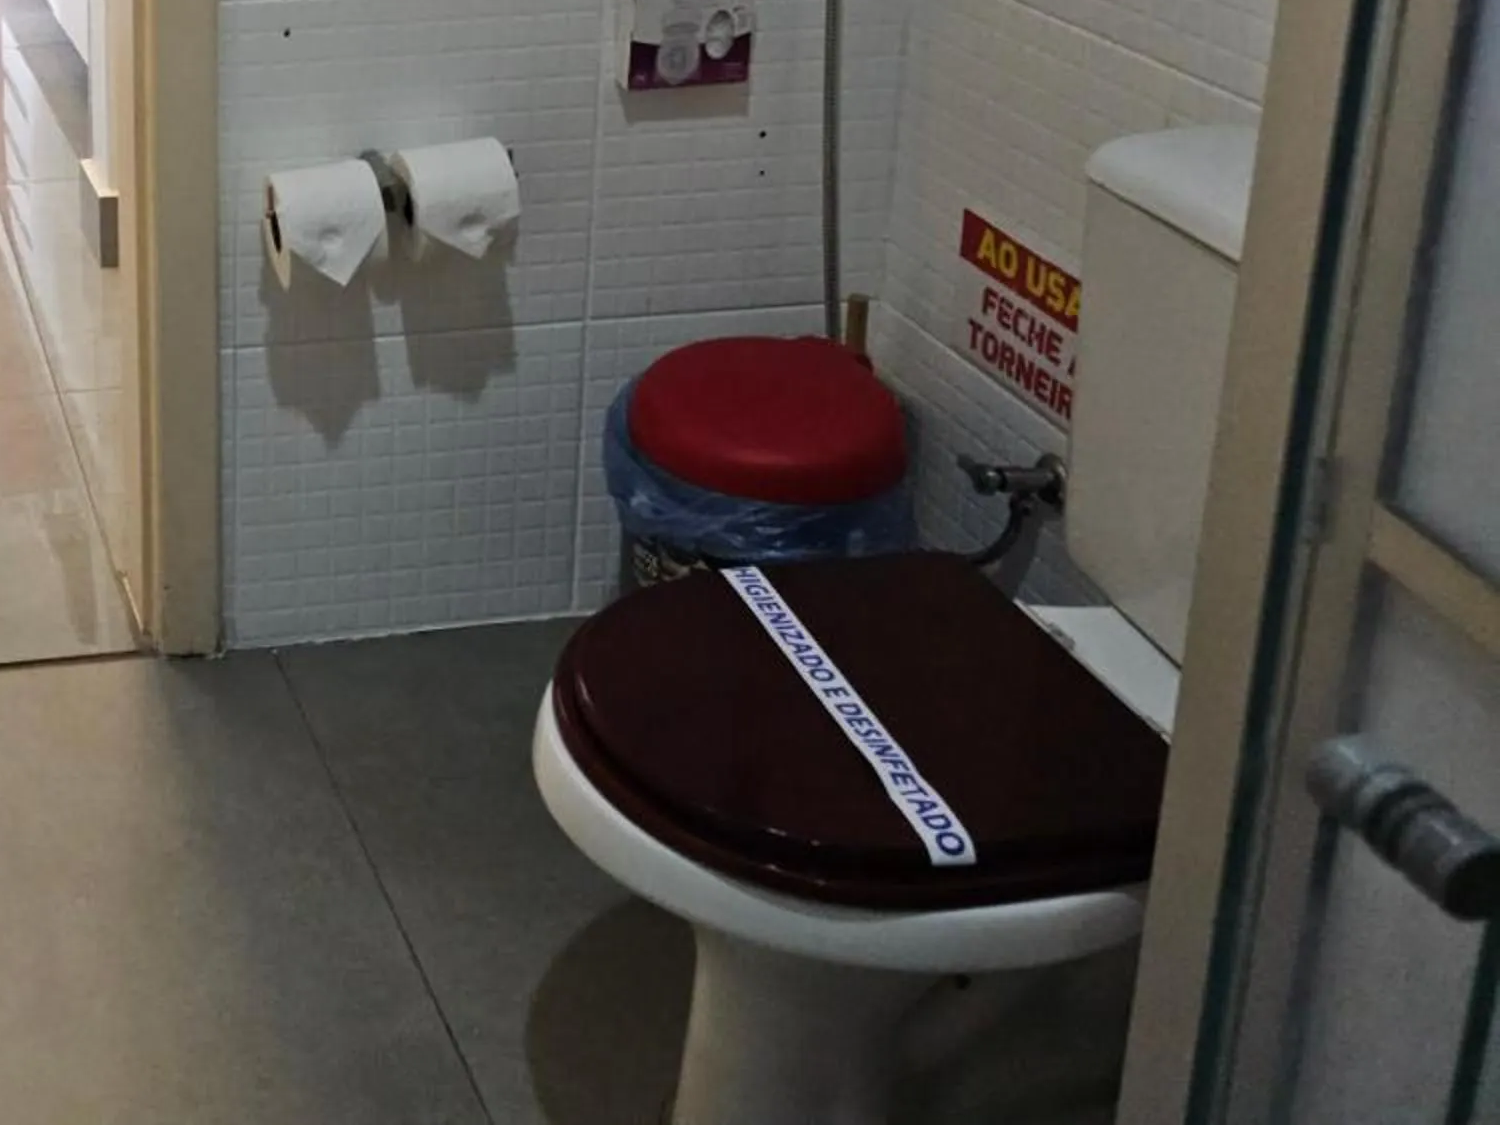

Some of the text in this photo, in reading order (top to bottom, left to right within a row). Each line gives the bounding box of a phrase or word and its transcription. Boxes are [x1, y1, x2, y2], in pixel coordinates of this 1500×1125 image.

[977, 228, 1018, 278] AO
[982, 286, 1064, 368] FECHE
[821, 686, 850, 699] E
[834, 702, 965, 856] DESINFETADO
